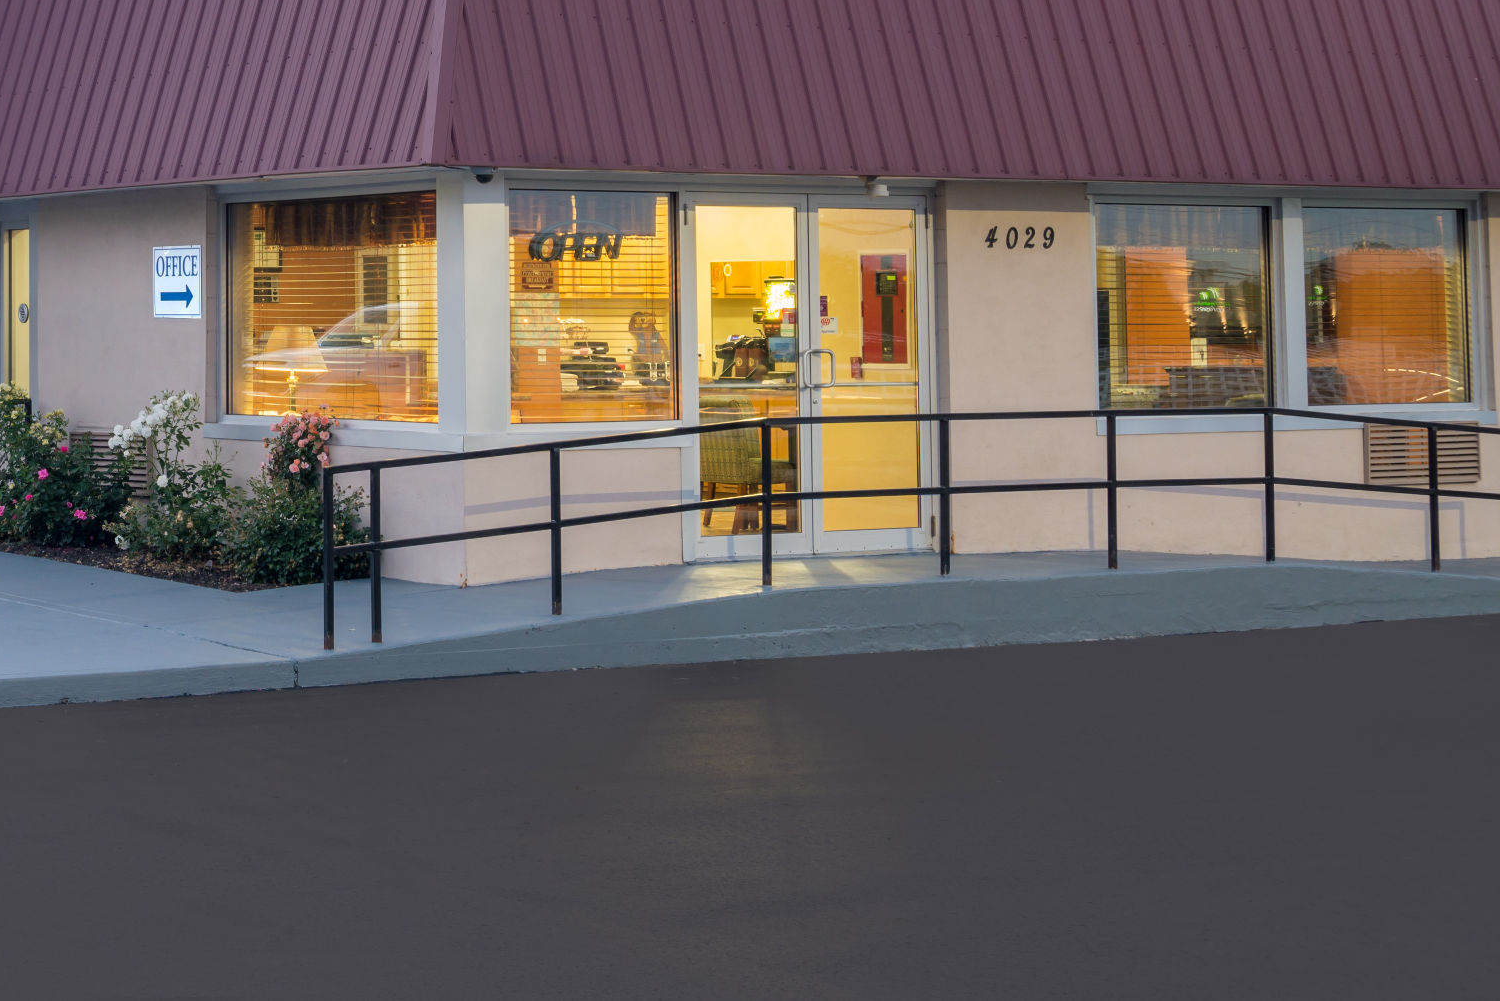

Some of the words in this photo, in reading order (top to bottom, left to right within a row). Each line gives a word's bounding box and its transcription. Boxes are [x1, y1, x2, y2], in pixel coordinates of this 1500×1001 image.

[529, 232, 622, 262] OPEN
[984, 225, 1055, 250] 4029
[156, 255, 198, 277] OFFICE
